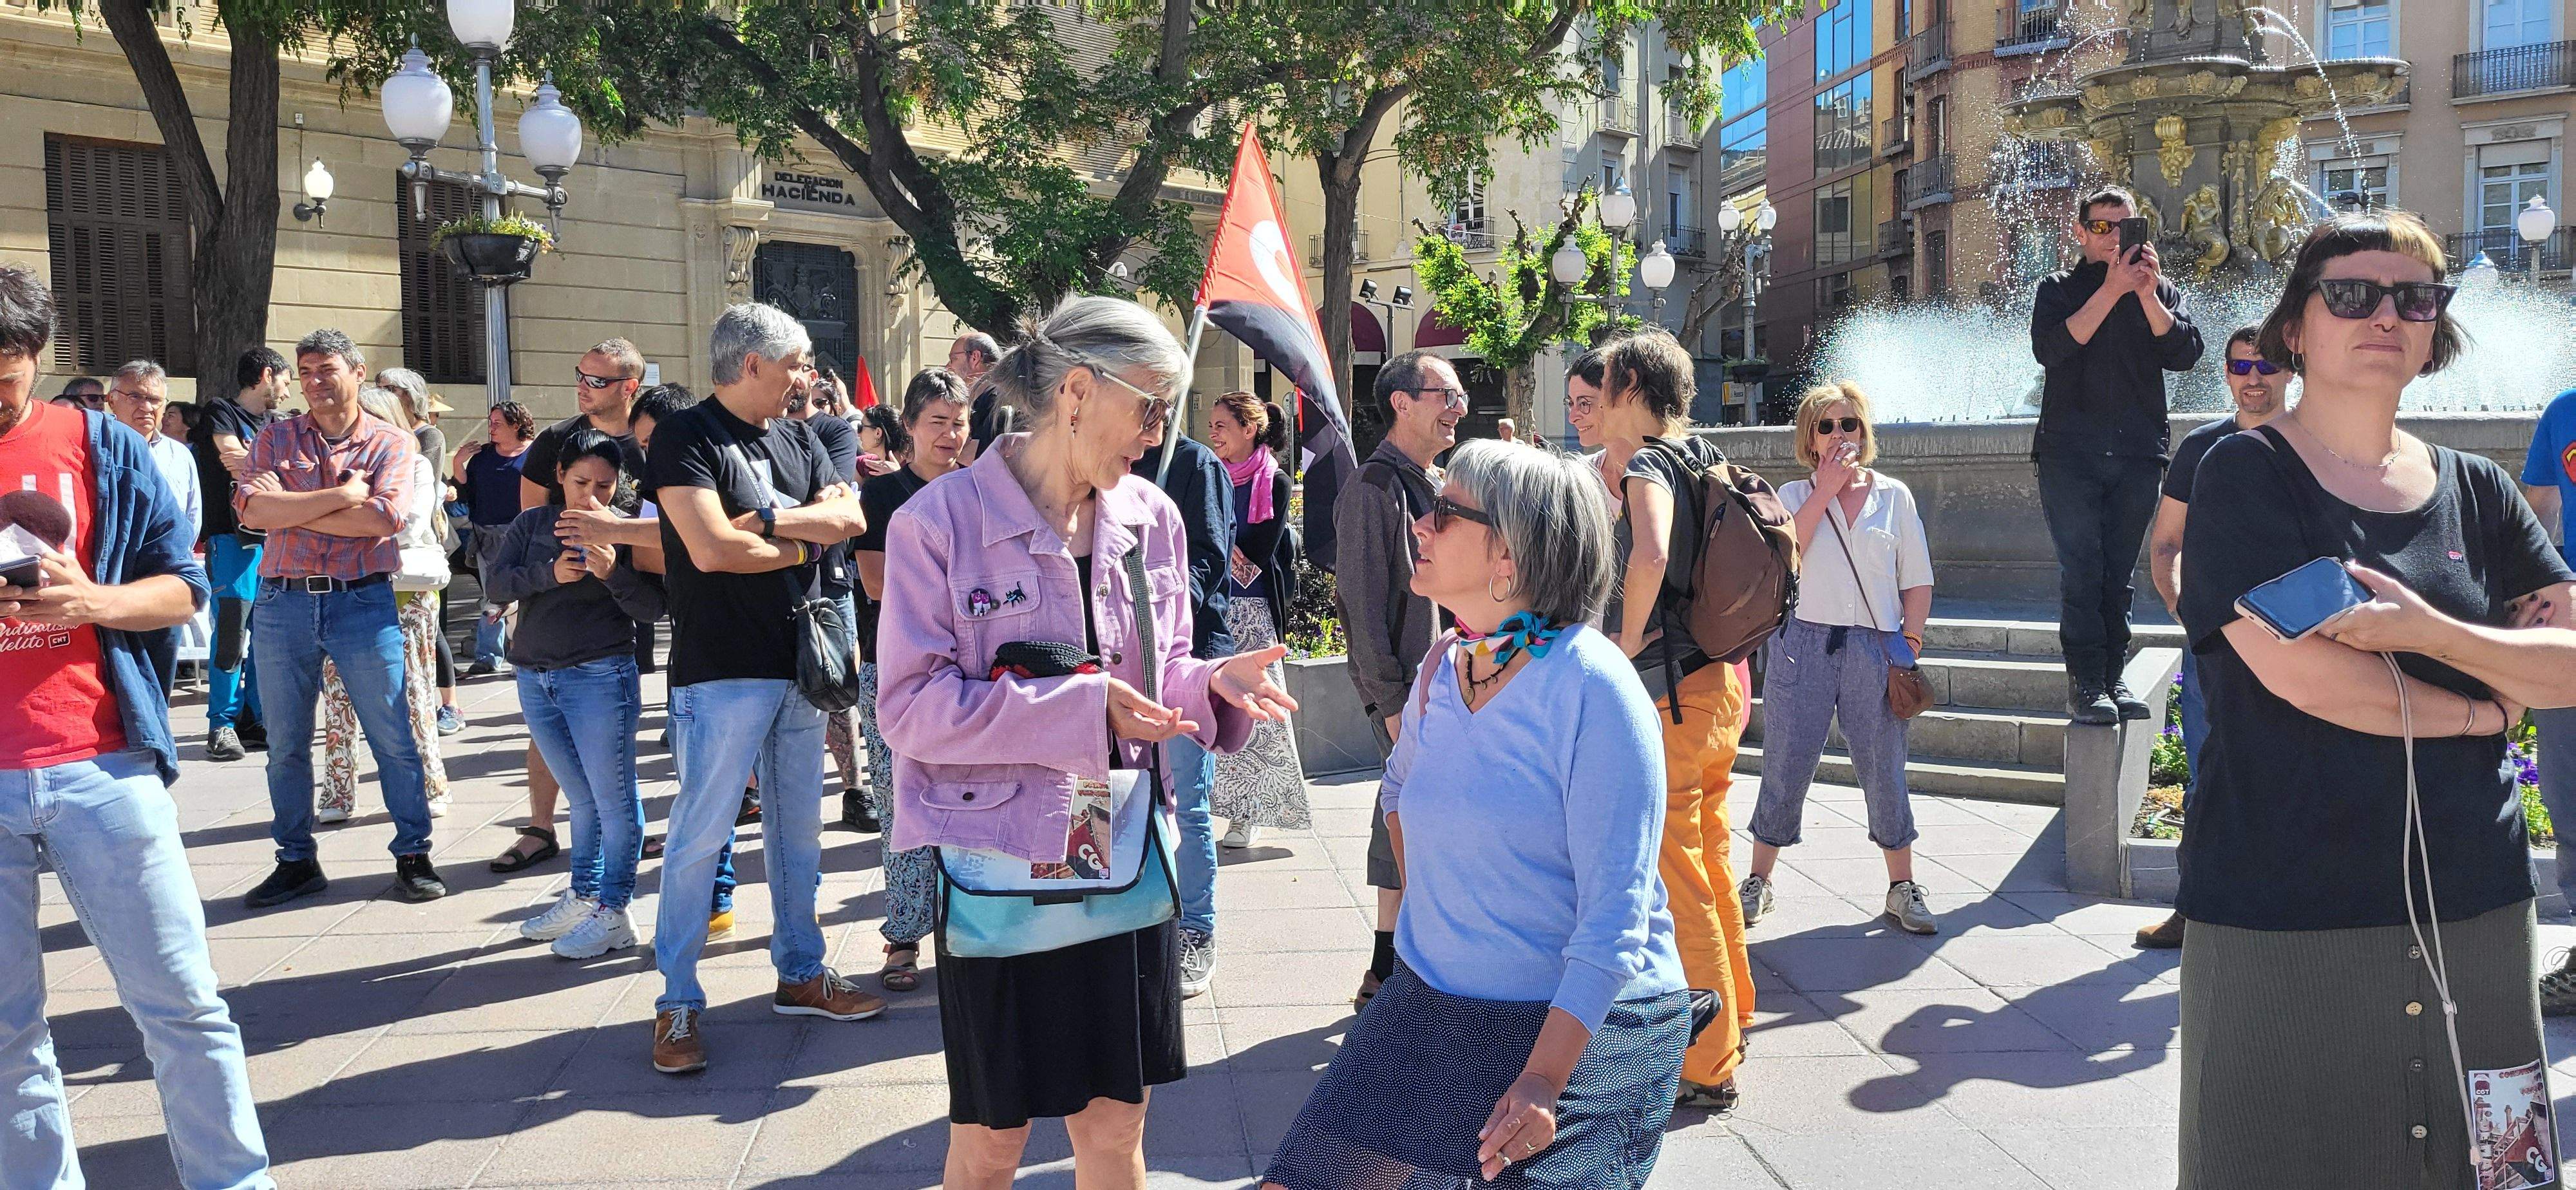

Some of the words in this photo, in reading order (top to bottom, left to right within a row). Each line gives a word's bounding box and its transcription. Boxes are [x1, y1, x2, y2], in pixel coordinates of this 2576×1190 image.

[775, 171, 843, 189] DELEGACION
[762, 184, 855, 205] HACIENDA
[52, 636, 67, 644] CNT
